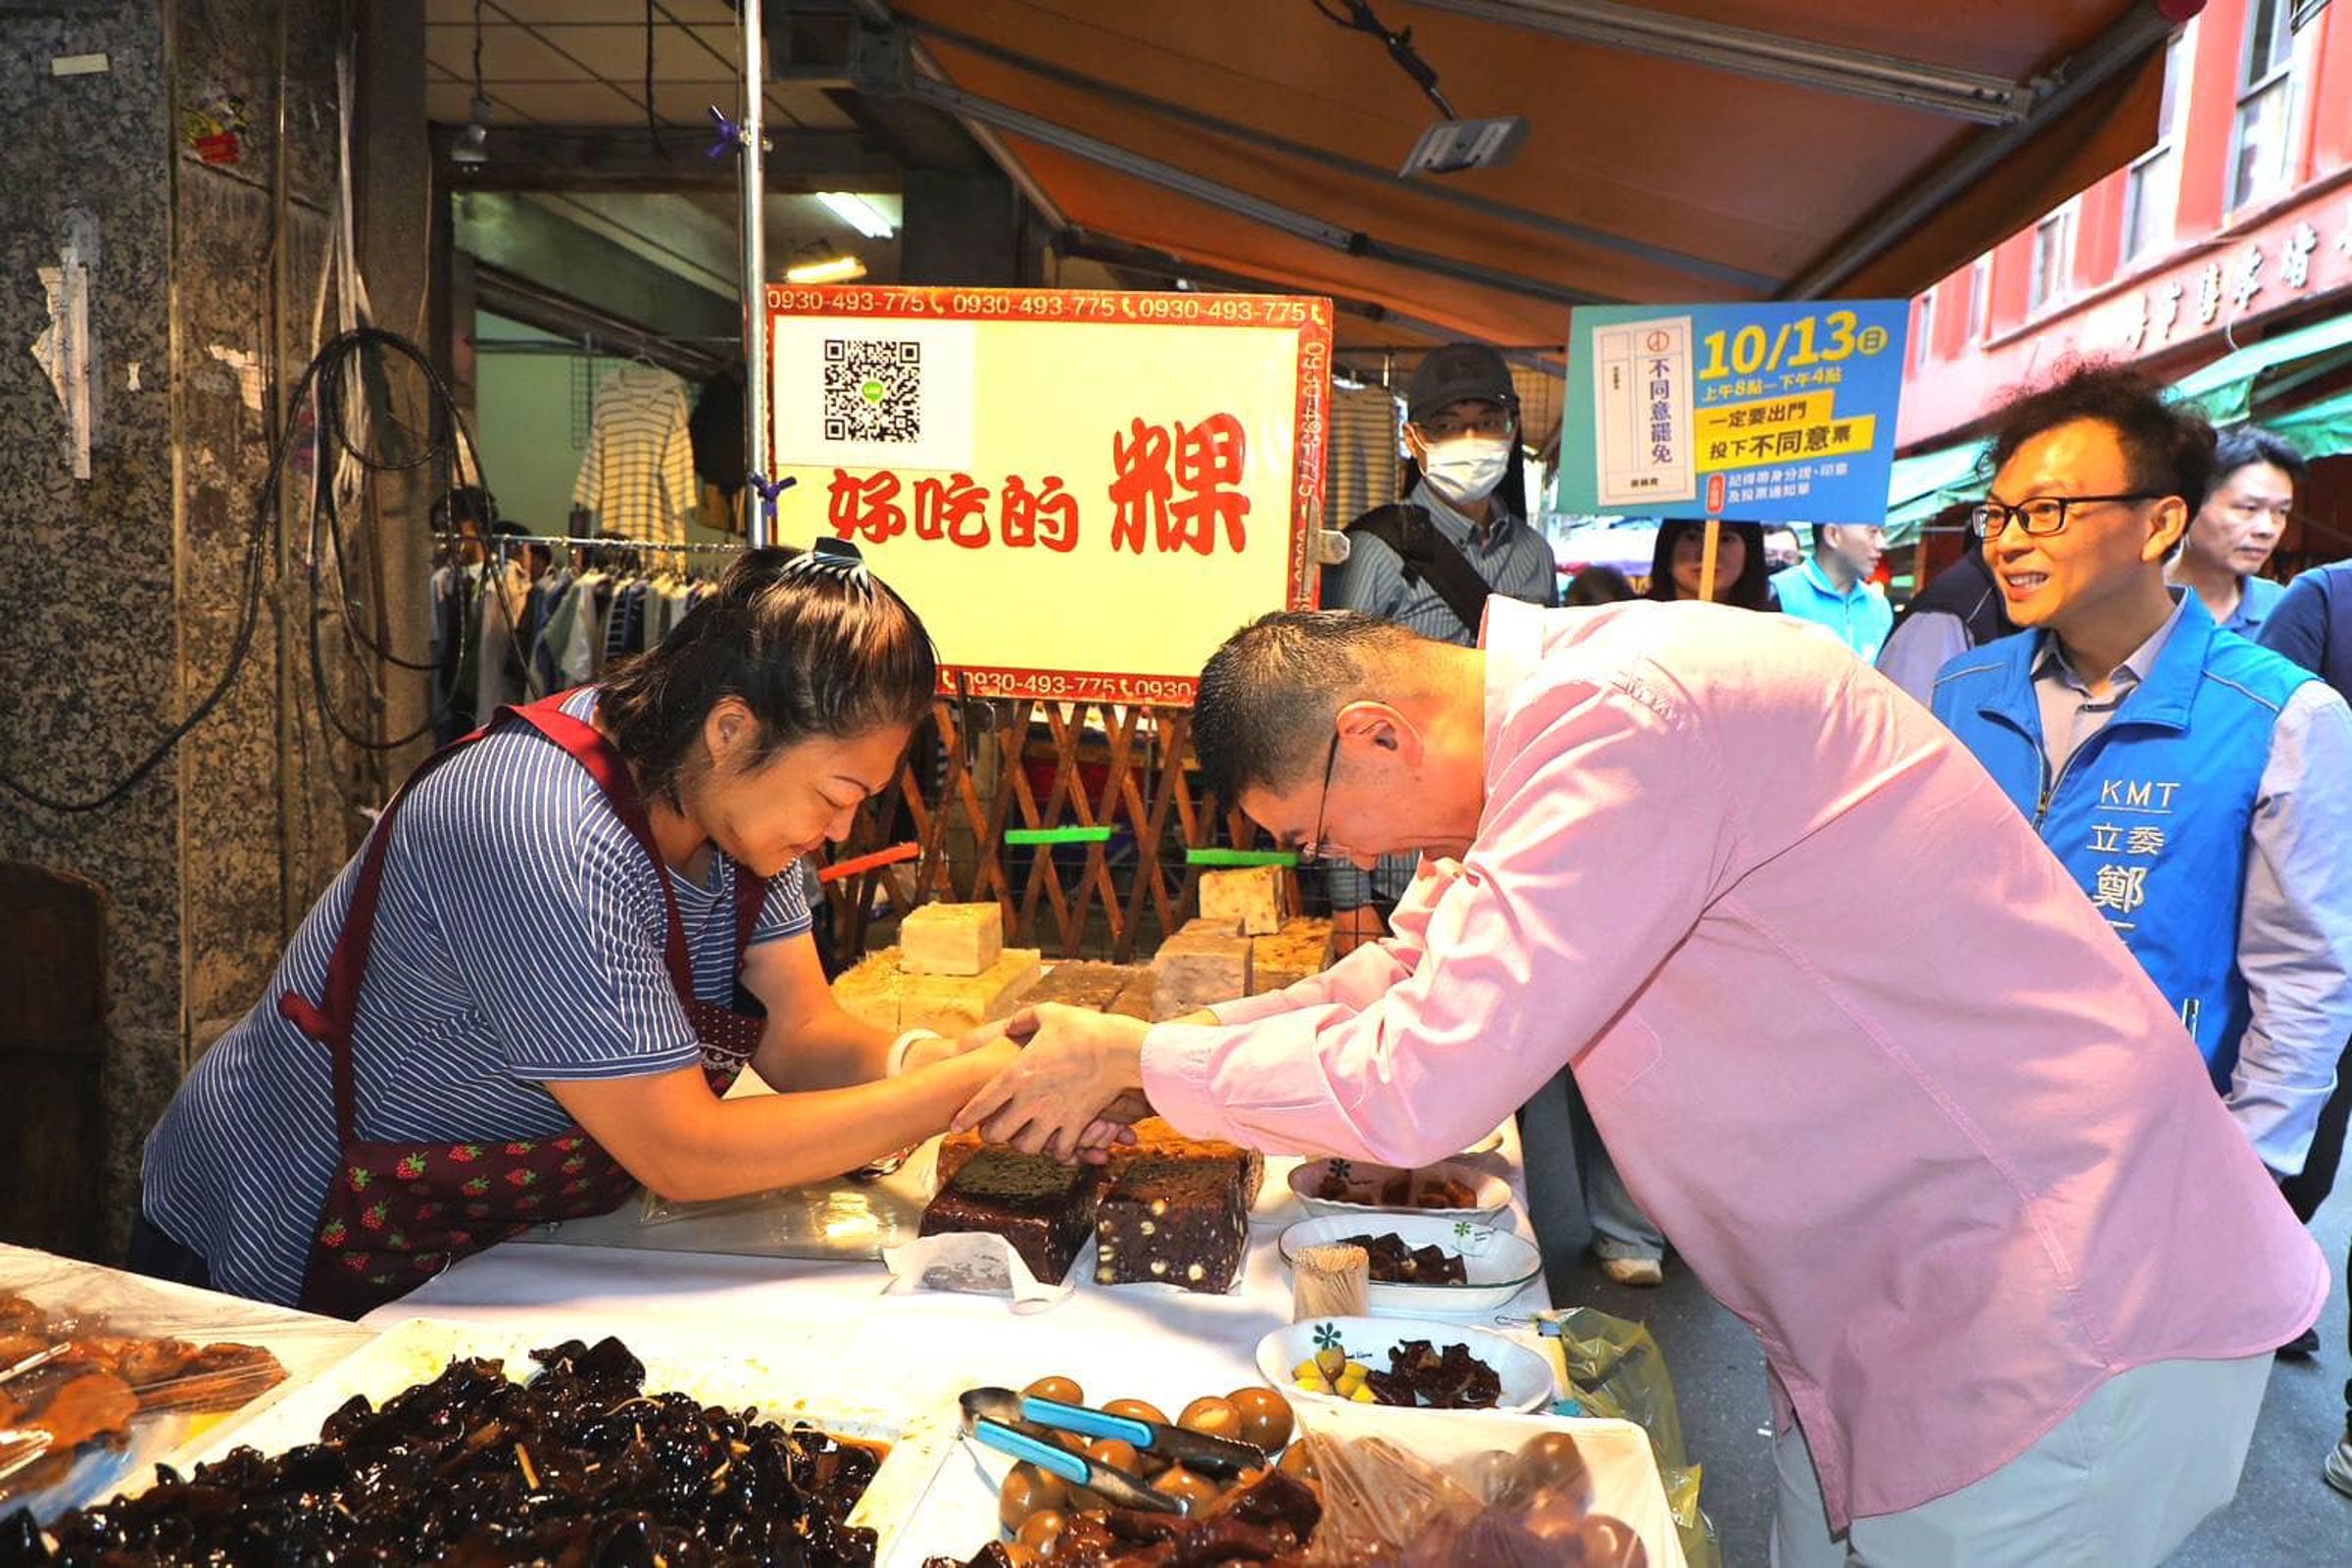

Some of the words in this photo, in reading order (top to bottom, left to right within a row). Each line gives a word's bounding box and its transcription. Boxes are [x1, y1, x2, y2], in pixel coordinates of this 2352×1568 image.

[767, 290, 926, 314] 0930-493-775
[953, 295, 1115, 318] 0930-493-775
[1139, 299, 1306, 321] 0930-493-775
[1697, 310, 1858, 381] 10/13
[1648, 358, 1673, 466] 不同意罷免
[1709, 403, 1806, 427] 一定要出門
[1709, 423, 1852, 461] 投下不同意票
[827, 468, 1078, 553] 好吃的
[1109, 413, 1250, 555] 粿
[1134, 679, 1197, 699] 0930-
[2100, 780, 2180, 808] KMT
[2086, 823, 2165, 856] 立委
[2092, 863, 2148, 930] 鄭
